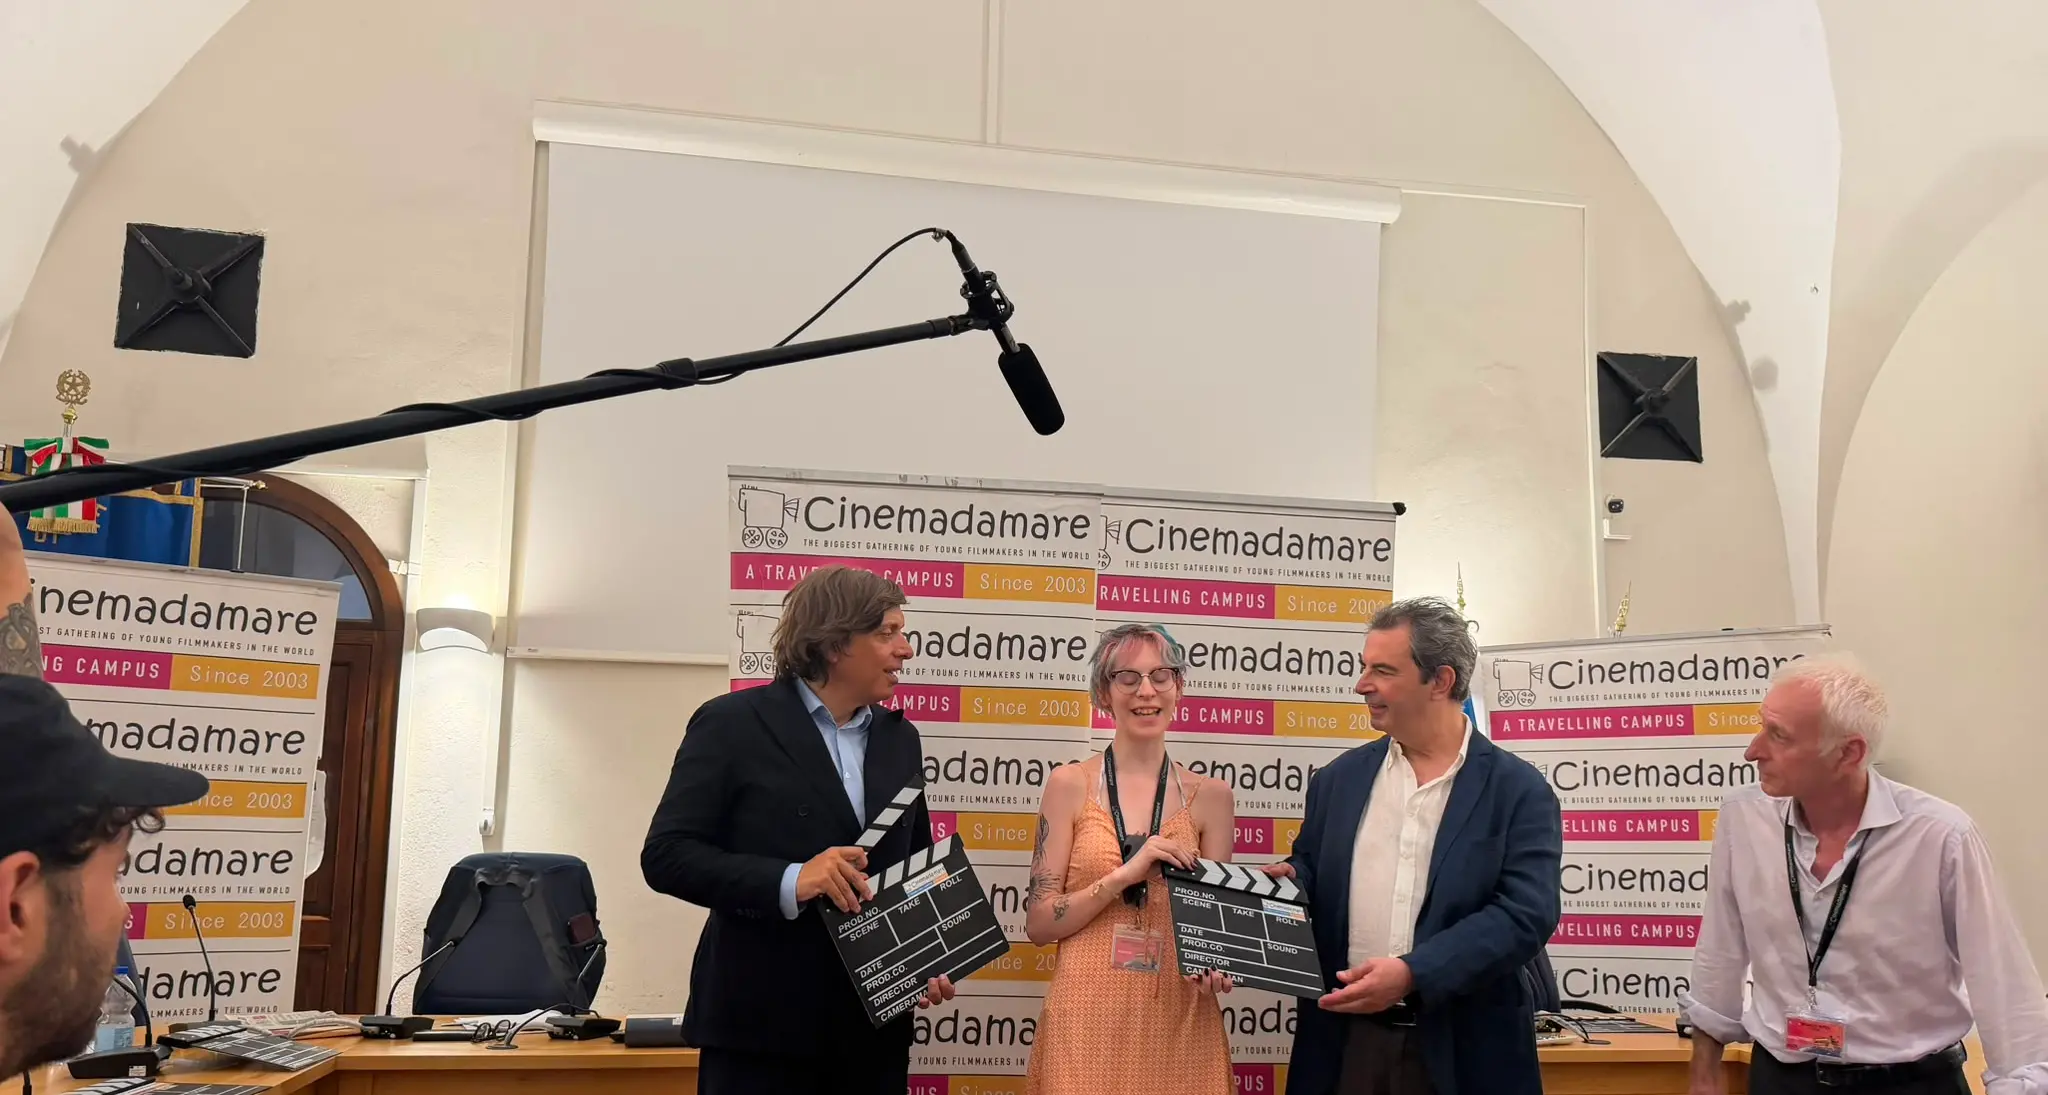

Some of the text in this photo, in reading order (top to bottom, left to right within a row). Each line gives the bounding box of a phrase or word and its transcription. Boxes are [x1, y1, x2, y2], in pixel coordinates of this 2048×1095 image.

[804, 496, 1091, 540] Cinemadamare
[1125, 518, 1392, 563] Cinemadamare
[803, 539, 1090, 561] THE BIGGEST GATHERING OF YOUNG FILMMAKERS IN THE WORLD
[746, 564, 754, 580] A
[884, 569, 954, 588] CAMPUS
[980, 573, 1033, 591] Since
[1044, 576, 1086, 594] 2003
[1126, 560, 1392, 583] THE BIGGEST GATHERING OF YOUNG FILMMAKERS IN THE WORLD
[1100, 585, 1192, 604] RAVELLING
[1200, 590, 1266, 609] CAMPUS
[1288, 596, 1337, 614] Since
[56, 628, 116, 640] GATHERING
[121, 632, 134, 642] OF
[139, 634, 173, 645] YOUNG
[178, 637, 242, 650] FILMMAKERS
[246, 642, 258, 652] IN
[262, 644, 279, 654] THE
[283, 646, 315, 656] WORLD
[76, 656, 161, 679] CAMPUS
[190, 665, 250, 686] Since
[262, 670, 309, 690] 2003
[916, 668, 926, 676] OF
[930, 669, 960, 678] YOUNG
[964, 670, 1021, 680] FILMMAKERS
[1025, 672, 1034, 680] IN
[1039, 672, 1054, 680] THE
[1059, 673, 1086, 682] WORLD
[1183, 680, 1228, 690] GATHERING
[1232, 682, 1242, 691] OF
[1246, 682, 1272, 692] YOUNG
[1277, 684, 1331, 694] FILMMAKERS
[1335, 686, 1344, 694] IN
[1549, 696, 1564, 704] THE
[1566, 694, 1600, 703] BIGGEST
[1604, 692, 1647, 702] GATHERING
[1651, 691, 1660, 699] OF
[1664, 690, 1691, 699] YOUNG
[1694, 688, 1748, 698] FILMMAKERS
[1752, 688, 1760, 696] IN
[884, 696, 950, 712] AMPUS
[973, 697, 1027, 716] Since
[1040, 700, 1080, 718] 2003
[1200, 707, 1264, 725] CAMPUS
[1286, 711, 1337, 729] Since
[1502, 712, 1759, 732] A TRAVELLING CAMPUS Since
[234, 764, 244, 773] IN
[250, 766, 266, 774] THE
[272, 767, 302, 775] WORLD
[246, 792, 293, 810] 2003
[927, 794, 956, 803] YOUNG
[960, 795, 1018, 804] FILMMAKERS
[1022, 796, 1032, 805] IN
[1245, 801, 1272, 810] YOUNG
[1276, 802, 1304, 810] FILMM
[1571, 796, 1604, 805] BIGGEST
[1608, 796, 1652, 804] GATHERING
[1656, 796, 1666, 804] OF
[1670, 794, 1696, 804] YOUNG
[973, 824, 1027, 841] Since
[1563, 818, 1690, 833] ELLING CAMPUS
[1234, 828, 1264, 843] PUS
[120, 886, 290, 894] OUNG FILMMAKERS IN THE WORLD
[1174, 886, 1218, 902] PROD.NO.
[850, 875, 963, 942] SCENE TAKE ROLL
[1182, 898, 1212, 910] SCENE
[1232, 908, 1256, 918] TAKE
[1276, 916, 1299, 927] ROLL
[238, 912, 284, 929] 2003
[838, 906, 882, 933] PROD.NO.
[1631, 924, 1696, 938] CAMPUS
[859, 910, 971, 979] DATE SOUND
[1180, 926, 1298, 955] DATE SOUND
[1182, 938, 1226, 953] PROD.CO.
[1184, 952, 1230, 968] DIRECTOR
[866, 964, 908, 992] PROD.CO.
[873, 976, 918, 1008] DIRECTOR
[150, 1008, 204, 1018] LMMAKERS
[224, 1006, 242, 1014] THE
[246, 1006, 278, 1014] WORLD
[880, 990, 929, 1022] CAMERAMA
[1618, 1006, 1662, 1014] GATHERING
[1245, 1046, 1272, 1055] YOUNG
[918, 1056, 947, 1066] YOUNG
[952, 1057, 1011, 1066] FILMMAKERS
[1016, 1058, 1026, 1066] IN
